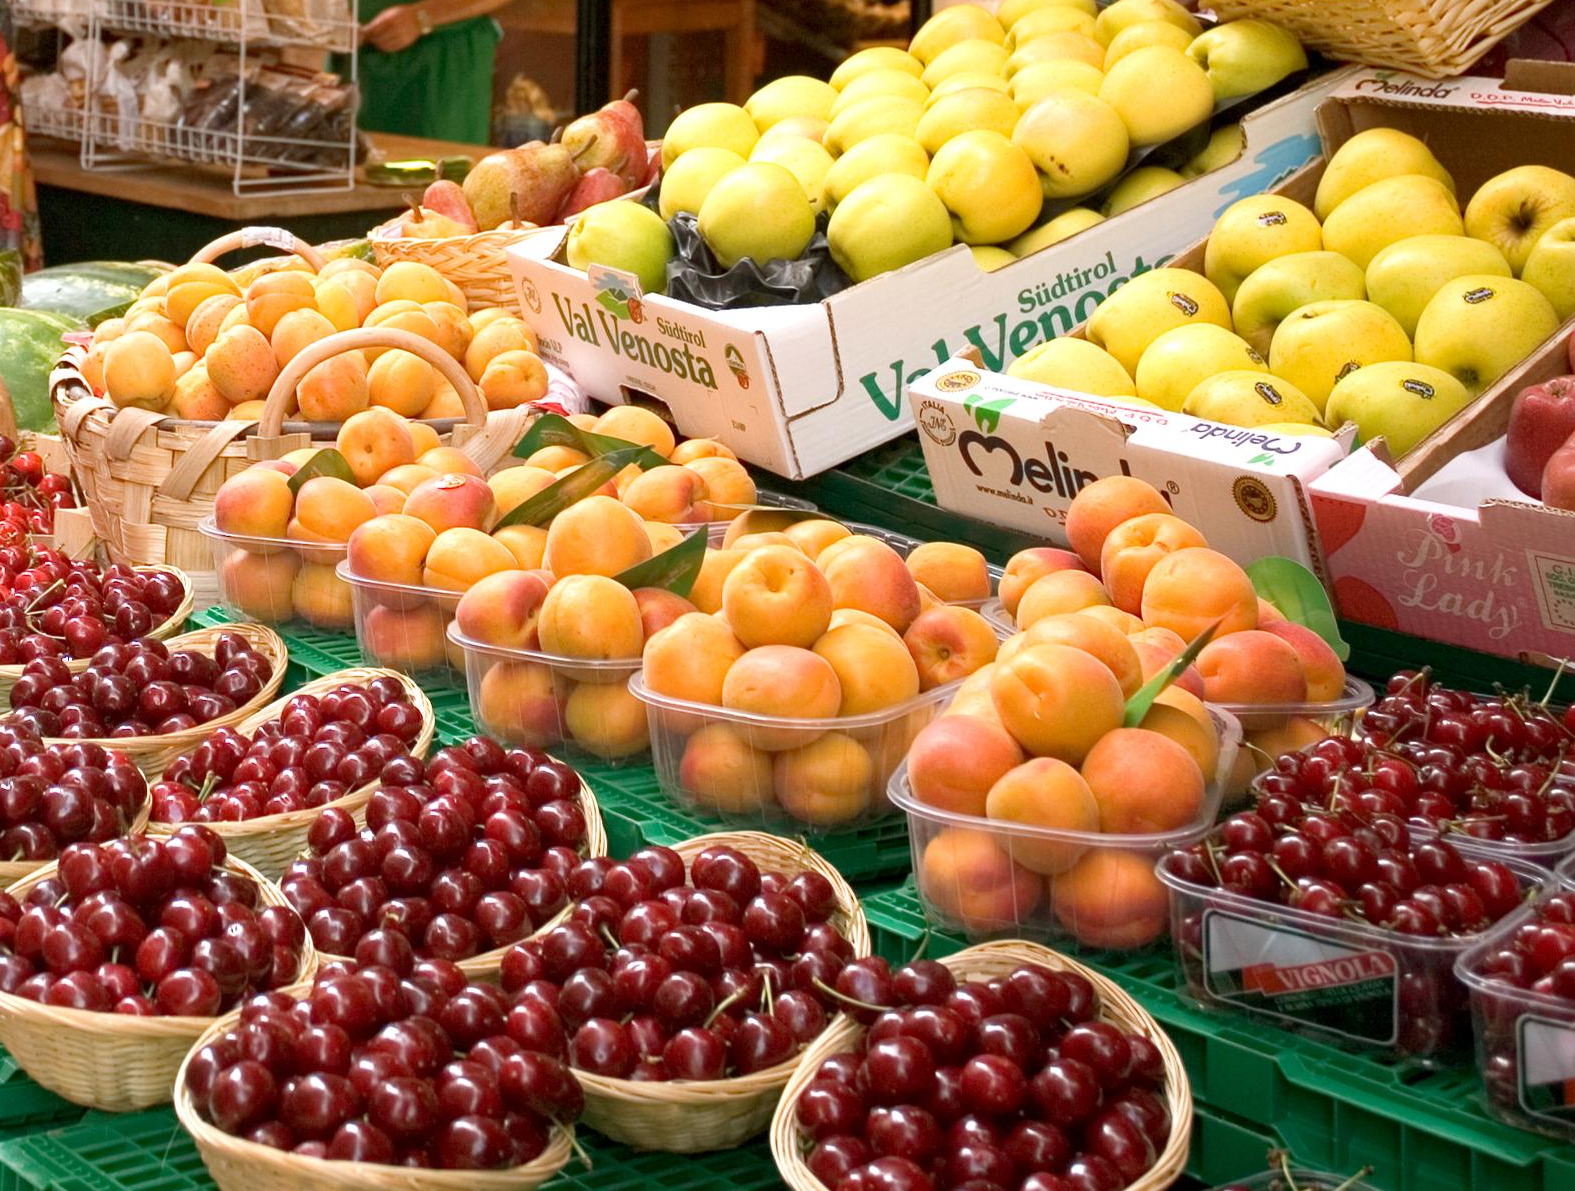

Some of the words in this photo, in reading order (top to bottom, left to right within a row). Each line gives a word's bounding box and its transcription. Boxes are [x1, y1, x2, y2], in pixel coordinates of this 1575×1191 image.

[1356, 78, 1451, 99] Melinda
[1018, 251, 1118, 314] Südtirol
[552, 292, 601, 347] Val
[596, 308, 719, 391] Venosta
[656, 317, 707, 349] Südtirol
[921, 400, 945, 414] ITALIA
[1190, 422, 1302, 455] Melinda
[958, 430, 1172, 508] Melin
[976, 484, 1034, 505] www.melinda.it
[1397, 528, 1518, 587] Pink
[1398, 569, 1521, 640] Lady
[1275, 954, 1388, 990] VIGNOLA
